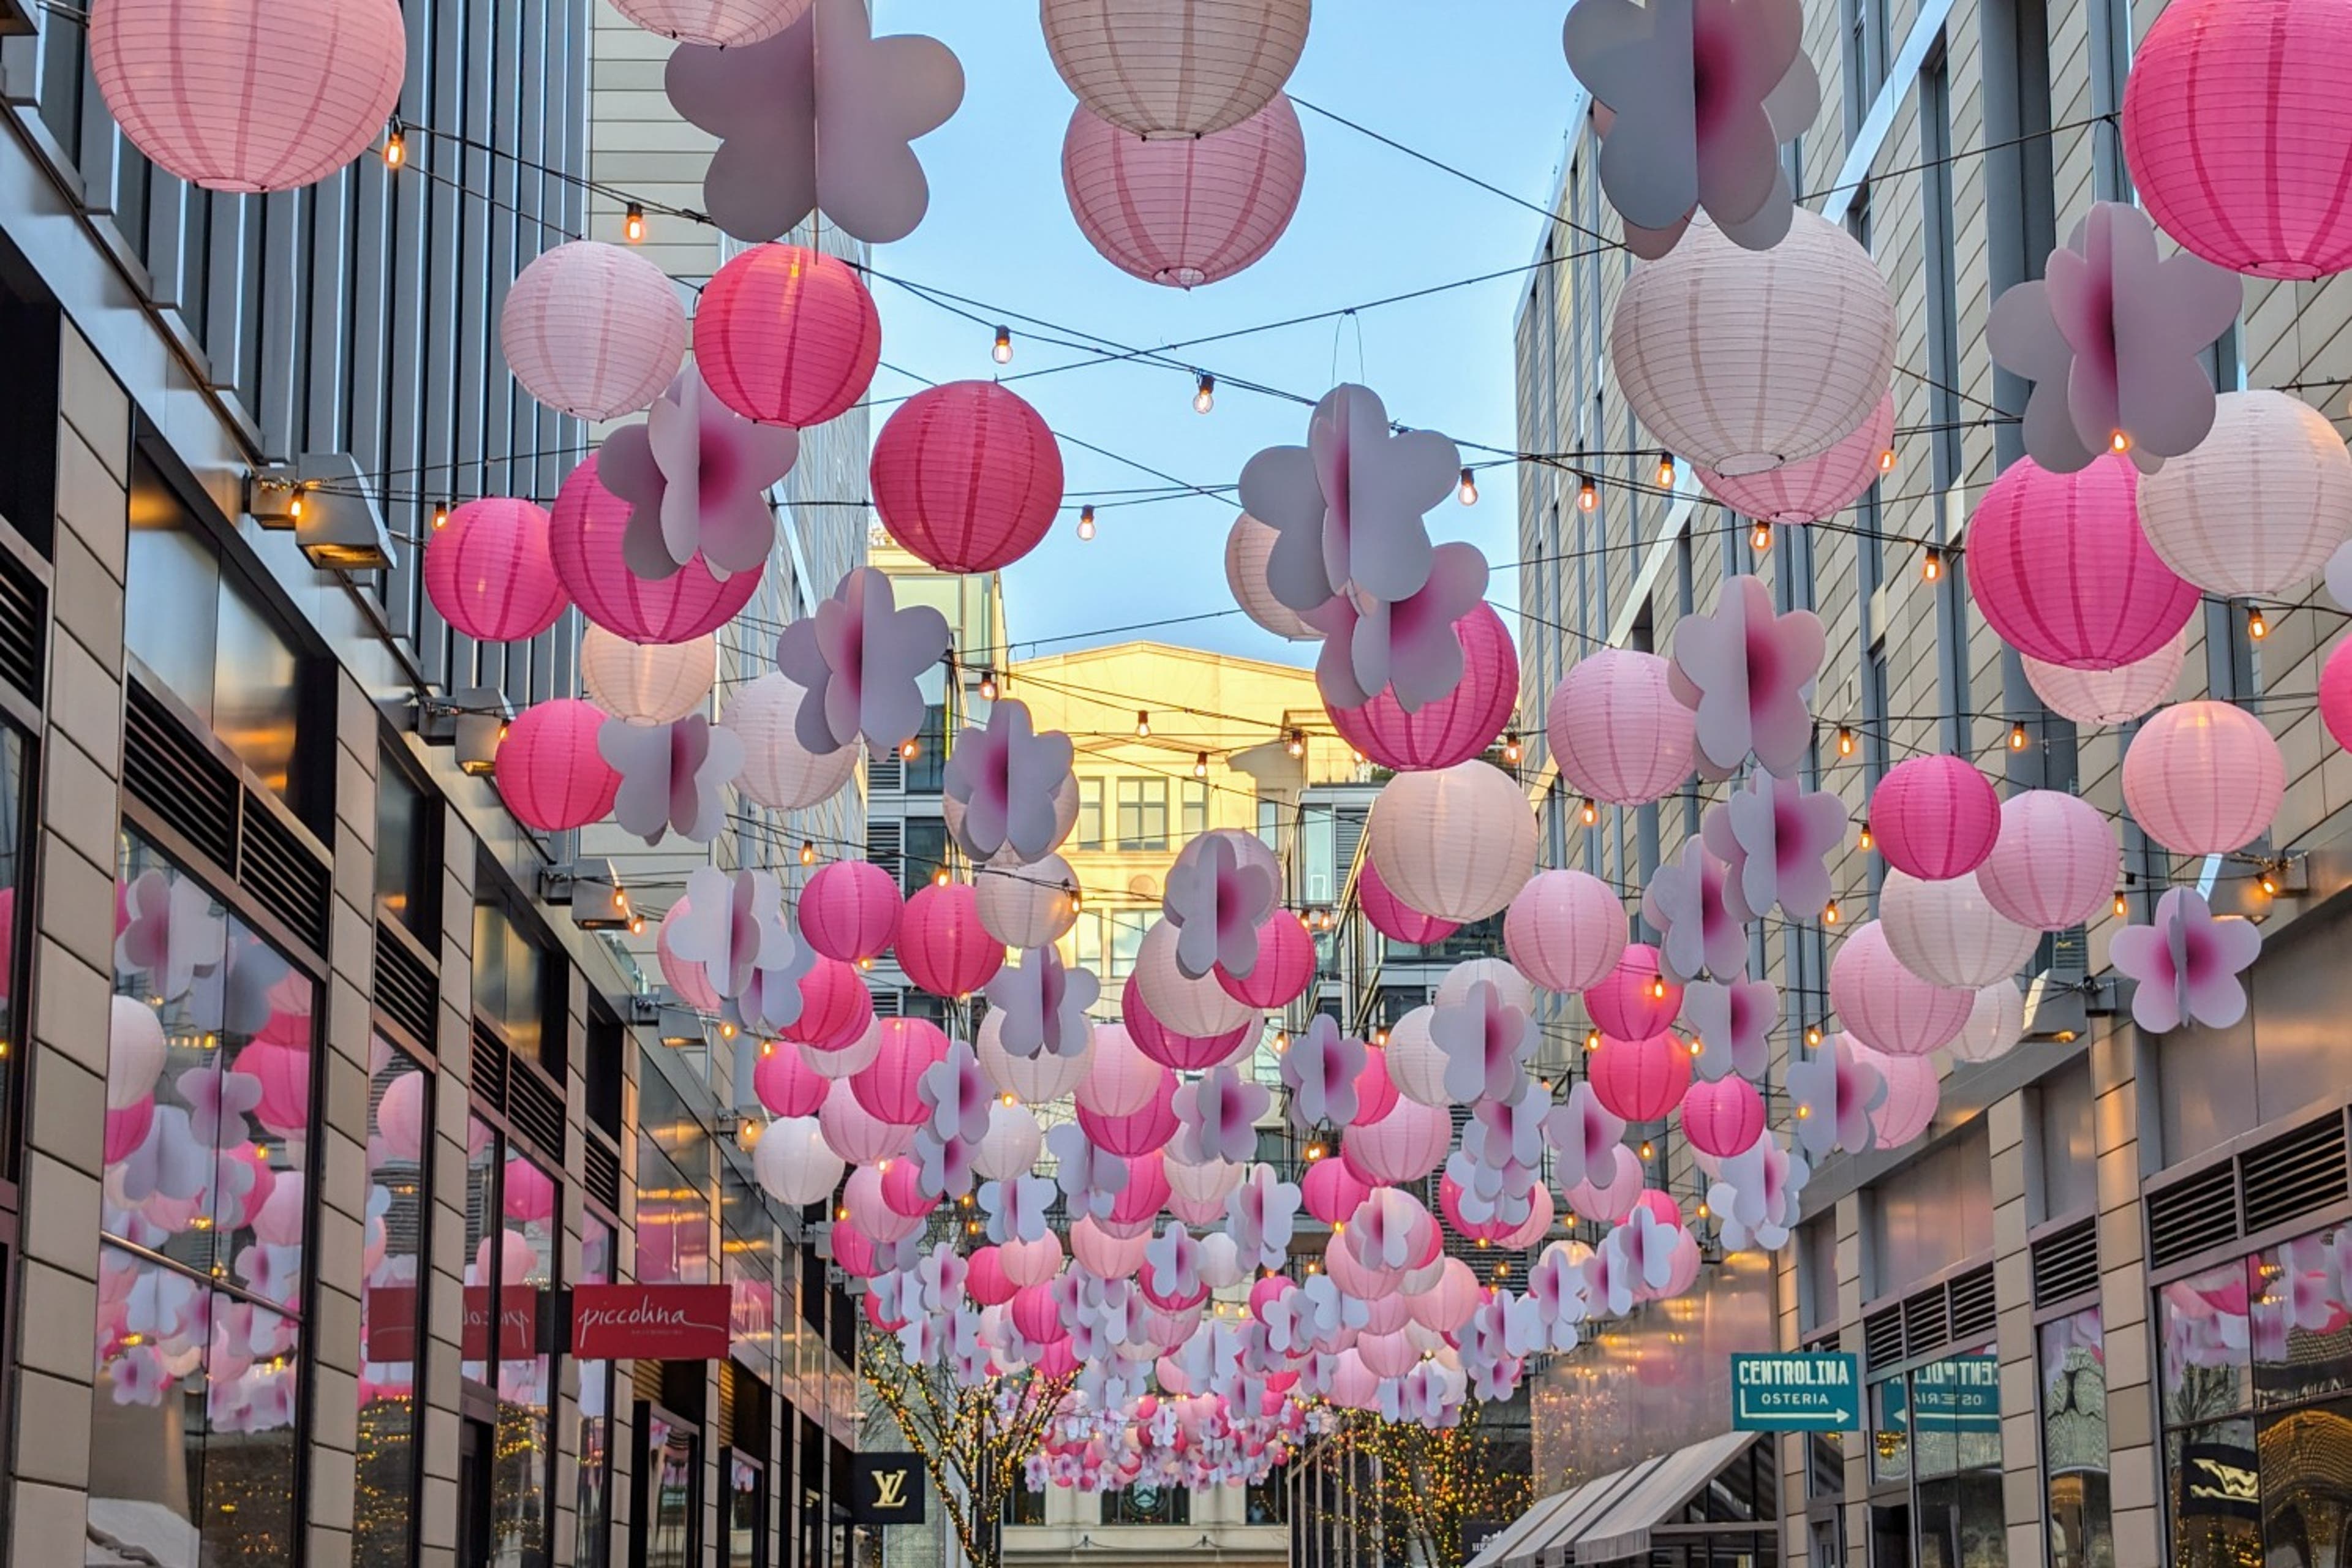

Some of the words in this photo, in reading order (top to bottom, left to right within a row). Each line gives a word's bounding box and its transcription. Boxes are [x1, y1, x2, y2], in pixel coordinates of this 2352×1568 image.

[578, 1294, 725, 1349] piccolina
[1738, 1360, 1849, 1385] CENTROLINA
[1762, 1393, 1829, 1405] OSTERIA
[871, 1469, 908, 1507] LV
